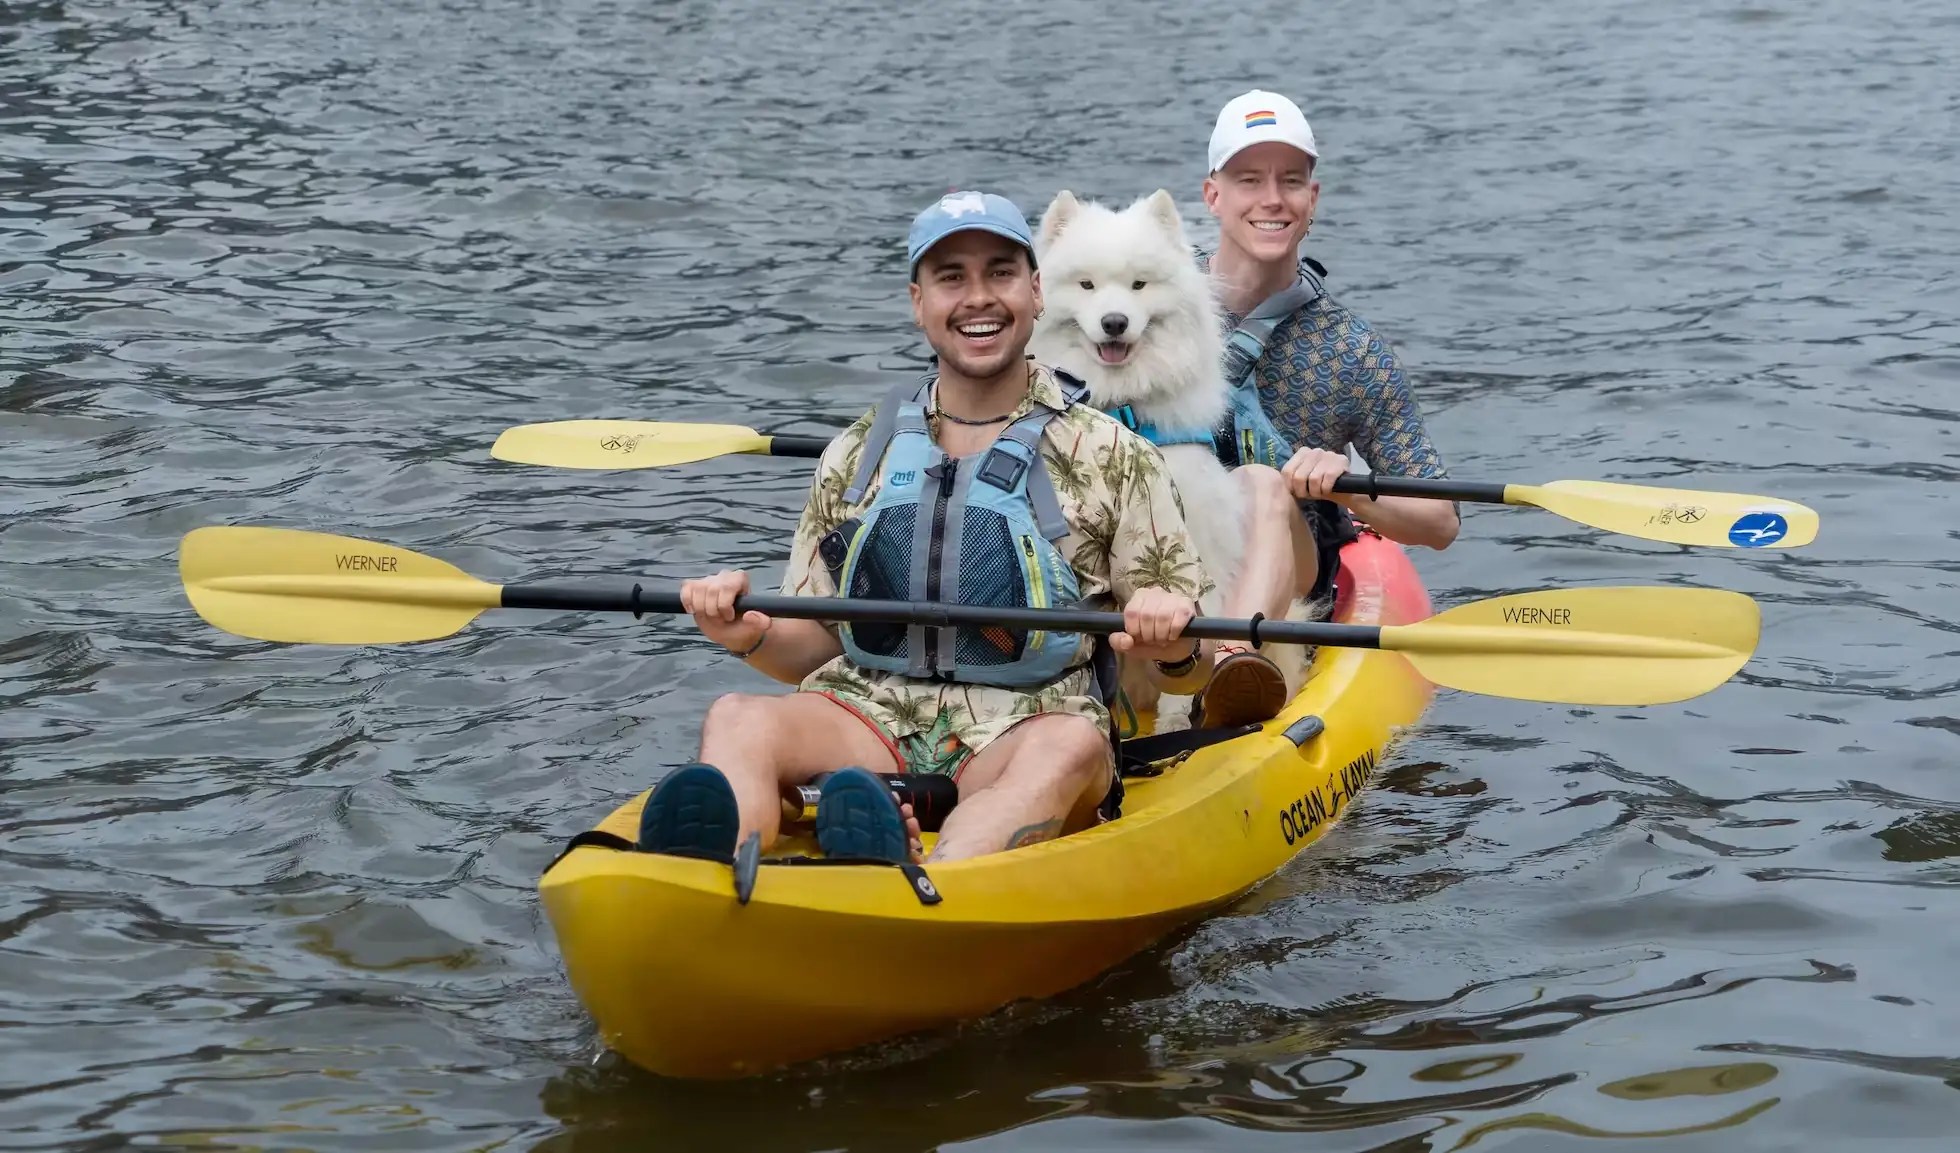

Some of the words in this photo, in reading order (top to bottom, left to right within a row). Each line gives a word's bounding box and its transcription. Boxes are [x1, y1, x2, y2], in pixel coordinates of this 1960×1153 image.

[335, 554, 398, 572] WERNER
[1502, 607, 1571, 625] WERNER
[1280, 785, 1327, 846] OCEAN
